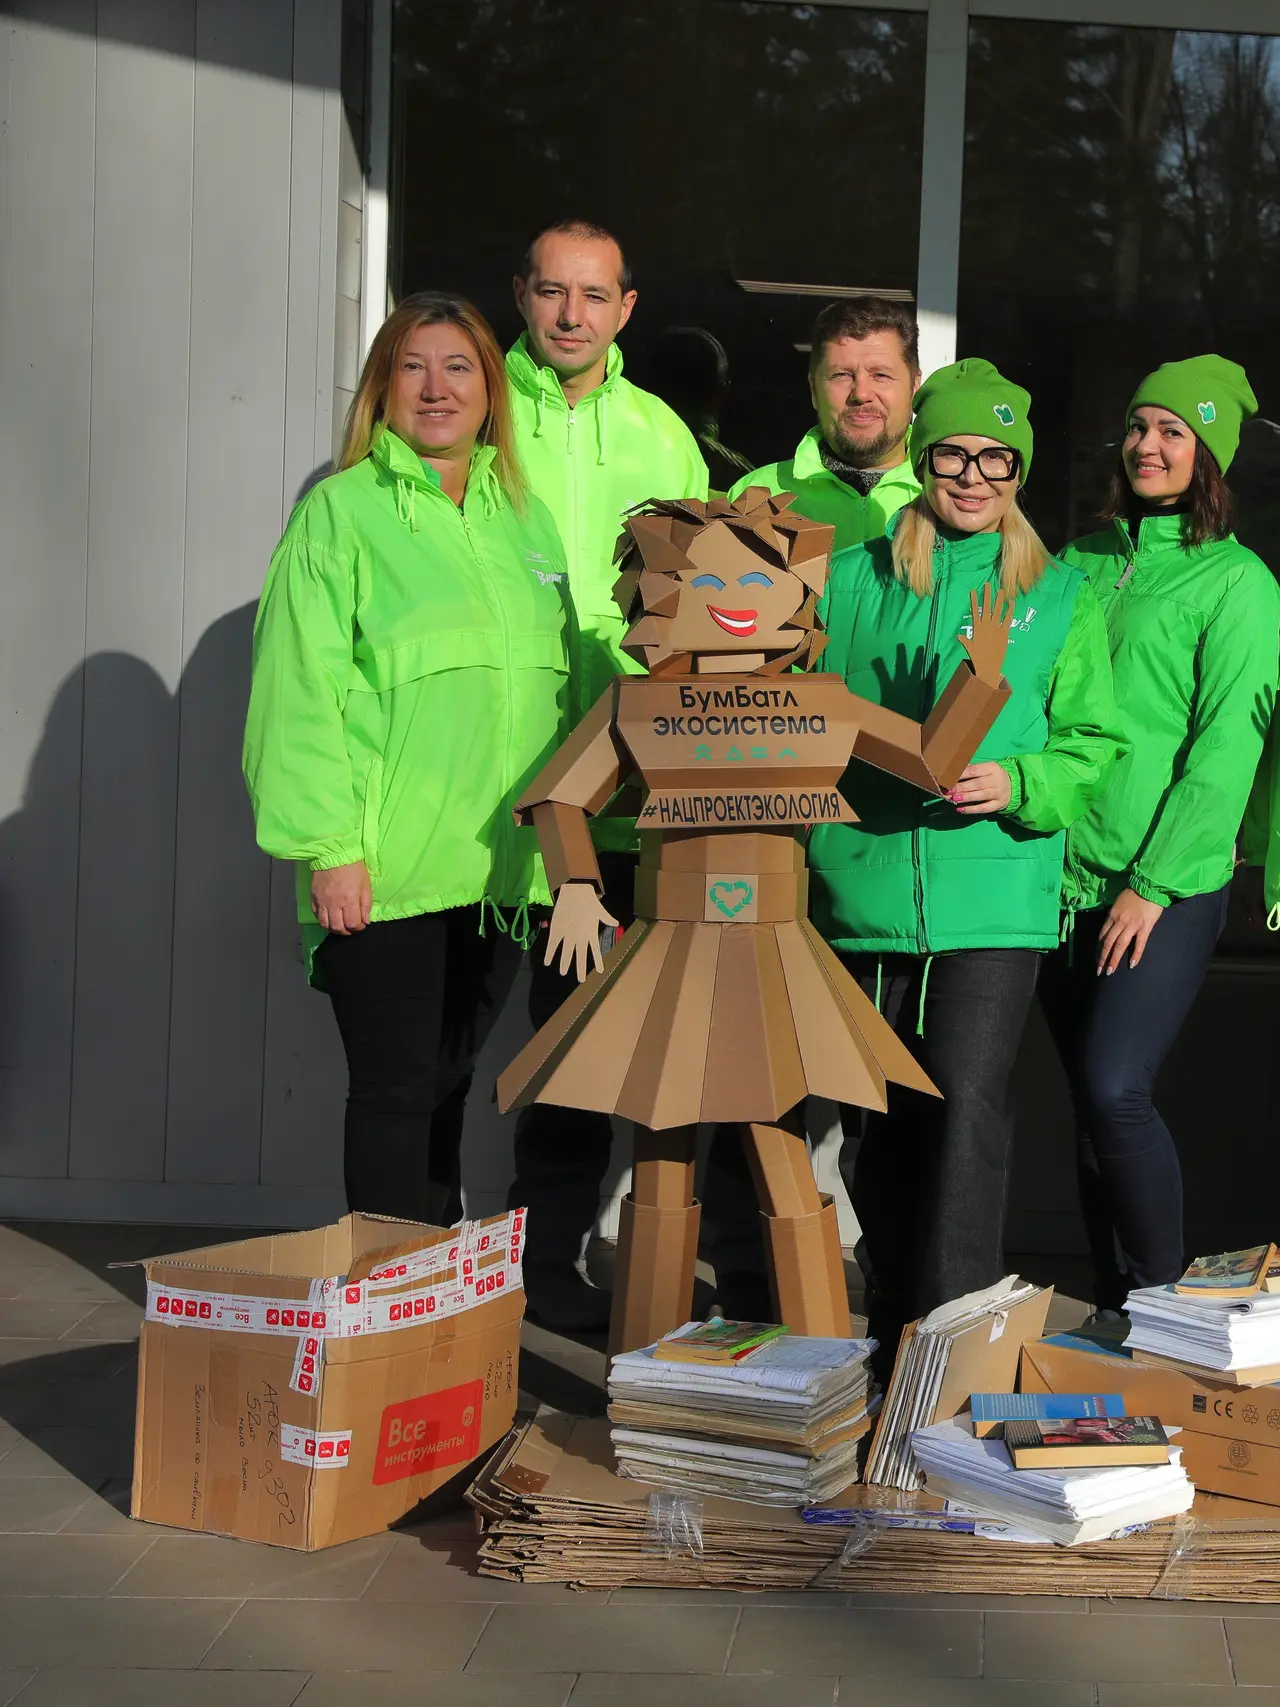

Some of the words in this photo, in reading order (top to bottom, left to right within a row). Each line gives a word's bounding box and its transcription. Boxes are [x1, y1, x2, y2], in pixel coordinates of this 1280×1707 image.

[680, 685, 799, 713] БумБатл
[652, 713, 827, 736] экосистема
[642, 792, 842, 825] #НАЦПРОЕКТЭКОЛОГИЯ
[388, 1416, 427, 1448] Все
[384, 1433, 466, 1468] инструменты
